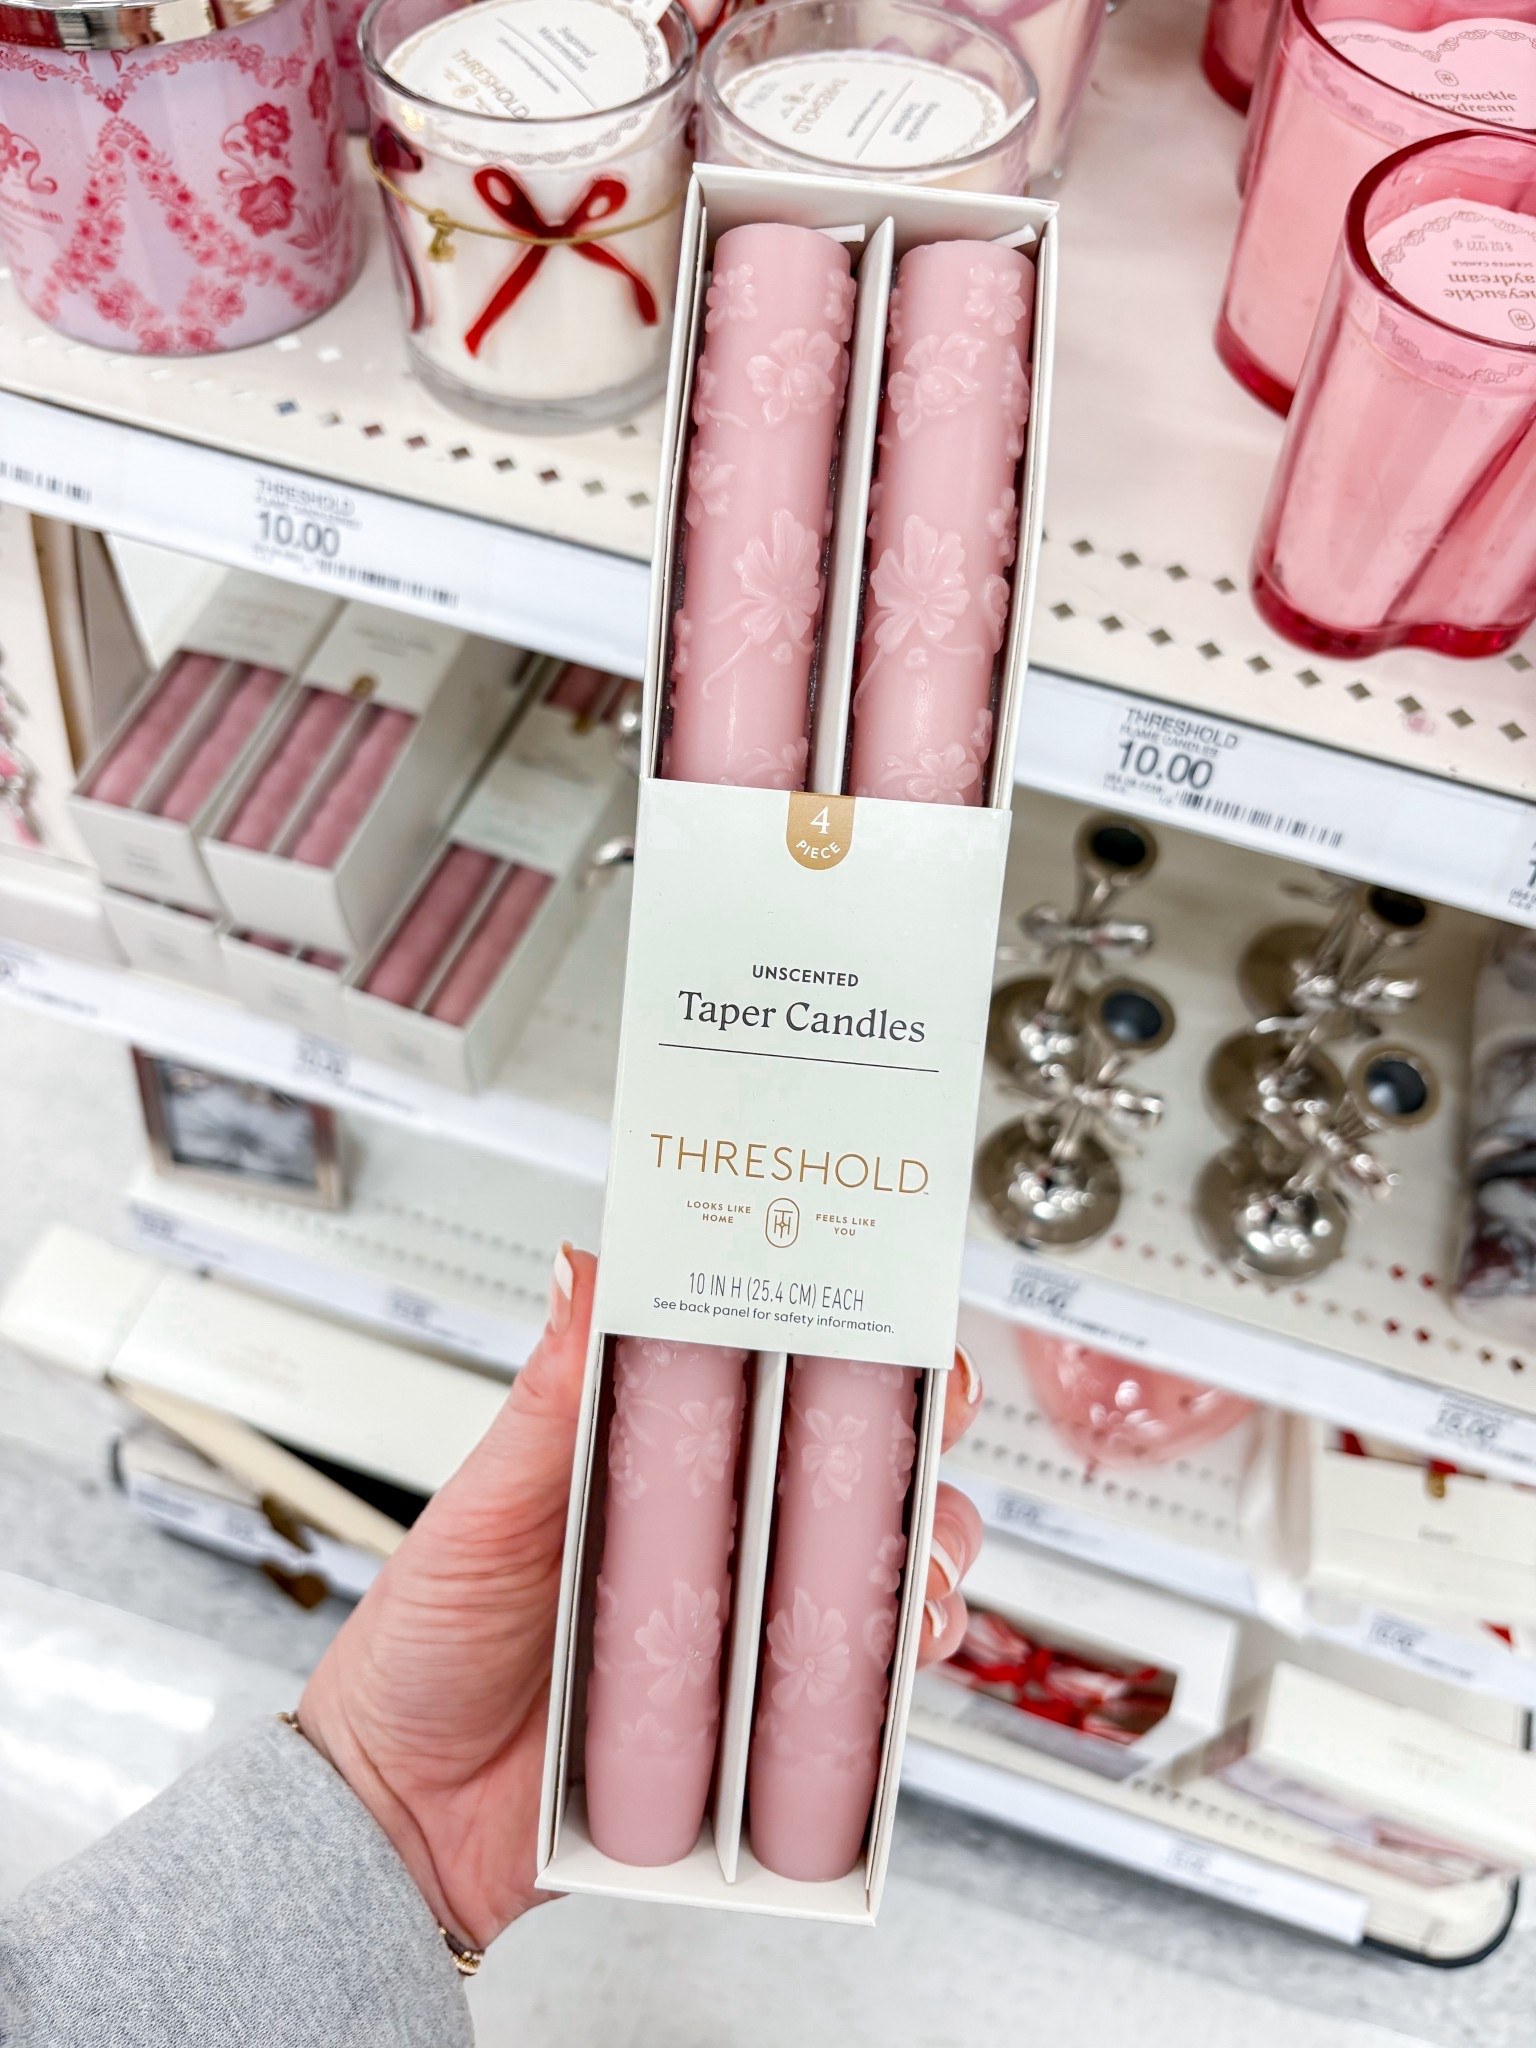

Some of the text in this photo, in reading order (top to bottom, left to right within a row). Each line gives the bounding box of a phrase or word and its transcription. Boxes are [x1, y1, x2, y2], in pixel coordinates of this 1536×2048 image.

[452, 48, 530, 119] THRESHOLD
[258, 510, 341, 557] 10.00
[1126, 708, 1238, 749] THRESHOLD
[1118, 740, 1213, 790] 10.00
[810, 805, 831, 835] 4
[796, 840, 841, 859] PIECE
[752, 965, 859, 987] UNSCENTED
[678, 990, 925, 1042] Taper Candles
[687, 1200, 751, 1214] LOOKS LIKE
[702, 1213, 734, 1224] HOME
[816, 1213, 876, 1228] FEELS LIKE
[834, 1226, 857, 1237] YOU
[689, 1272, 864, 1312] 10 IN H (25.4 CM) EACH
[653, 1297, 895, 1334] See back panel for safety information.
